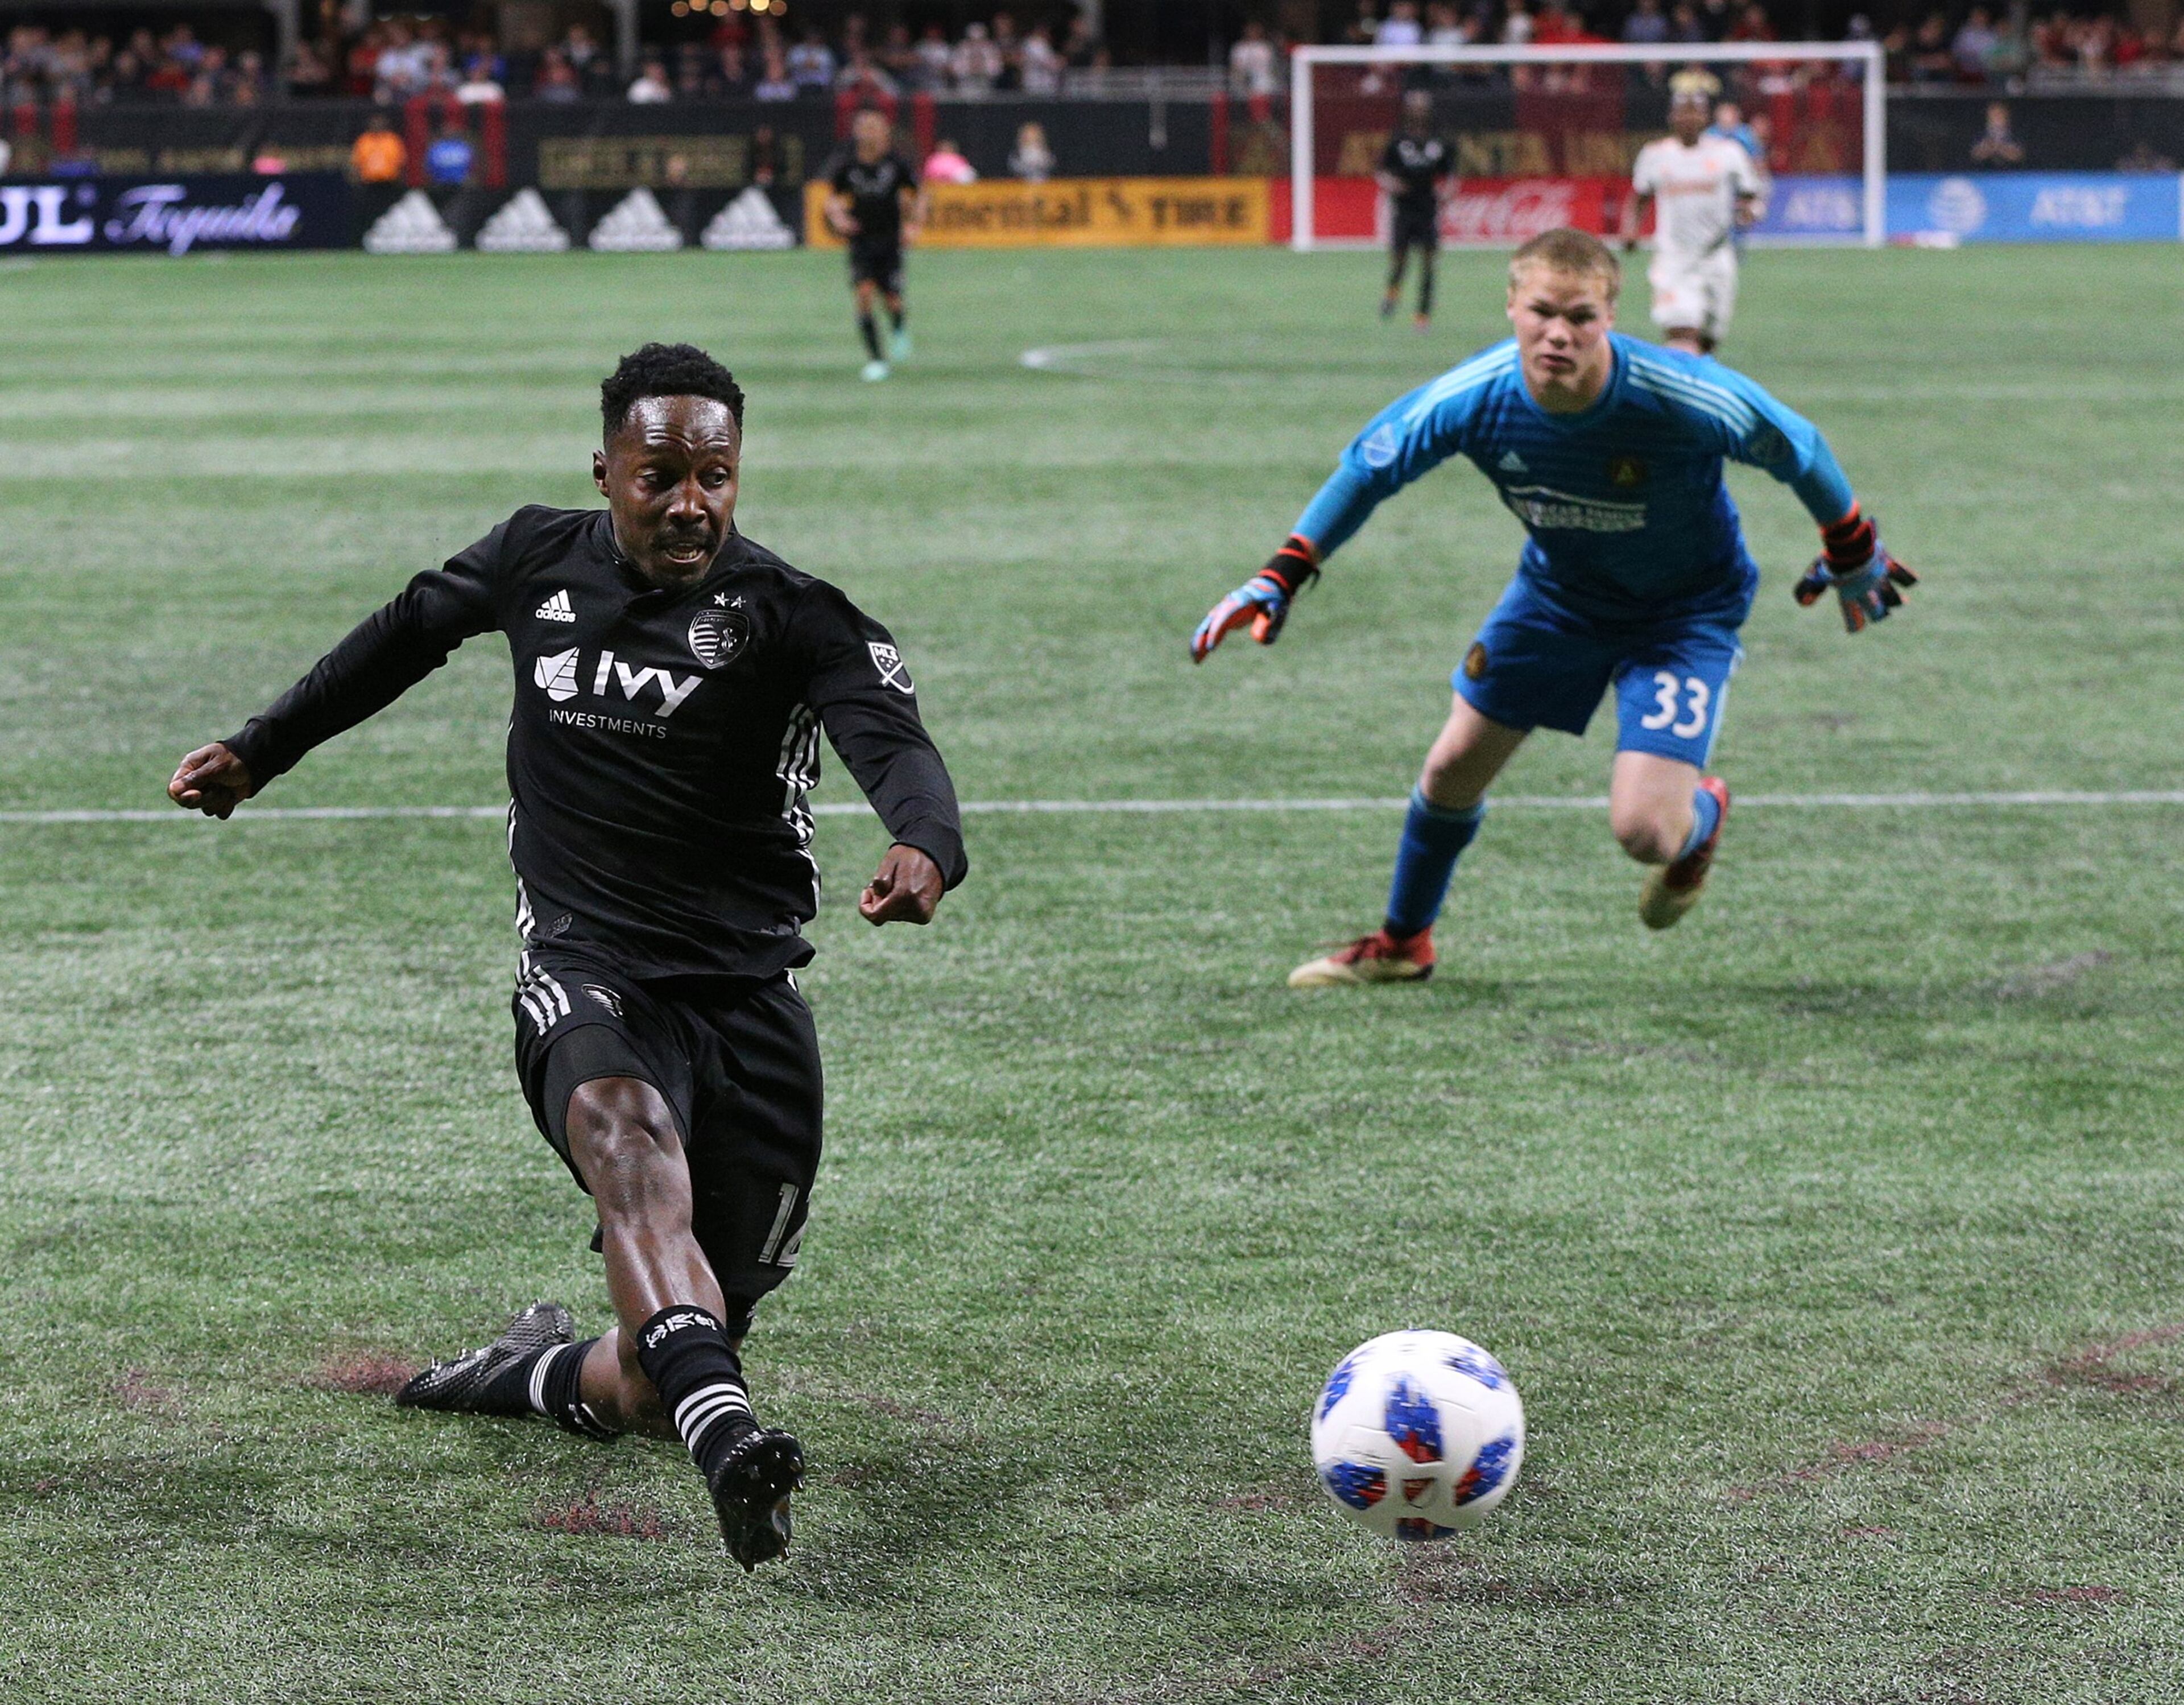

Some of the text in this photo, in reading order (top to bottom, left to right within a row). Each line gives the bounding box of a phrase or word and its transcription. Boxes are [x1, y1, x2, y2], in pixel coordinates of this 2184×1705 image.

[104, 182, 300, 256] Tequila
[535, 608, 577, 623] adidas
[874, 646, 899, 662] MLS
[593, 650, 704, 718] Ivy
[1641, 670, 1710, 740] 33
[549, 709, 667, 739] INVESTMENTS
